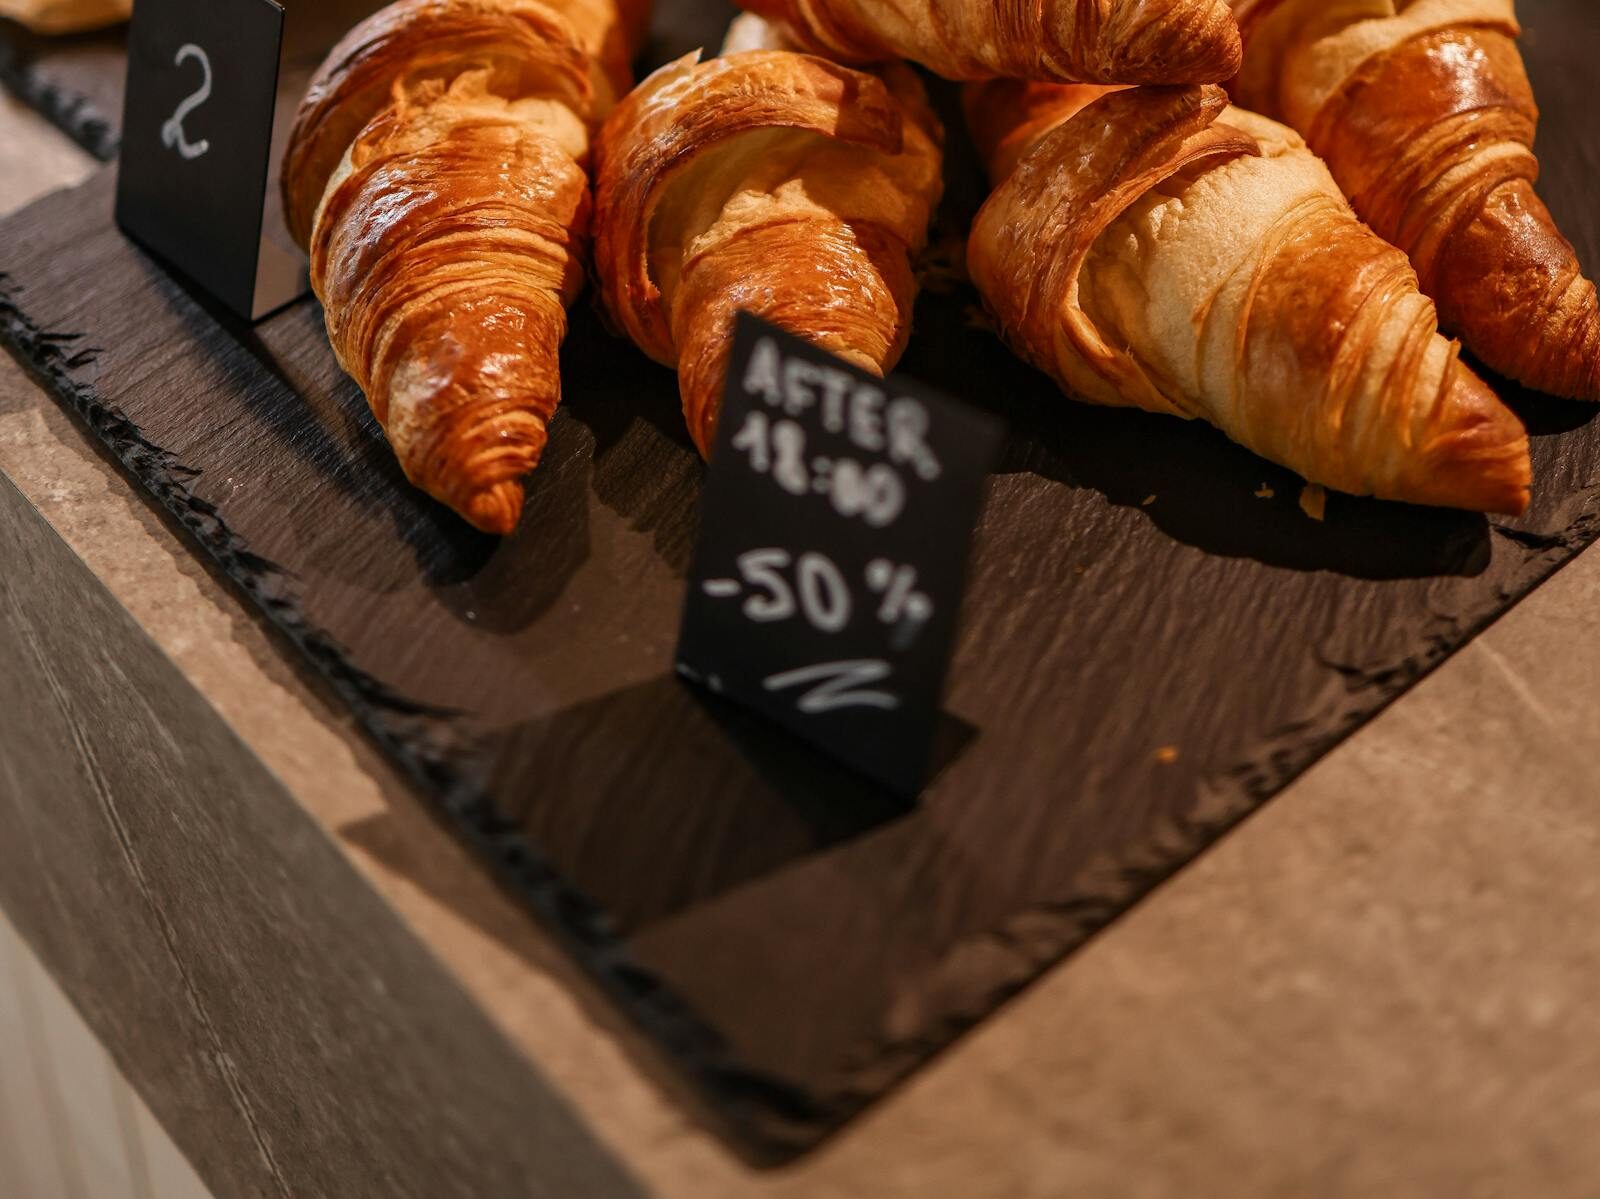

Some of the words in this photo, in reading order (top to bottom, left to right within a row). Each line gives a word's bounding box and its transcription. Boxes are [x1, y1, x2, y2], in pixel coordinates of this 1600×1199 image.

[161, 44, 212, 158] 2
[743, 337, 941, 481] AFTER
[733, 411, 905, 527] 18:00
